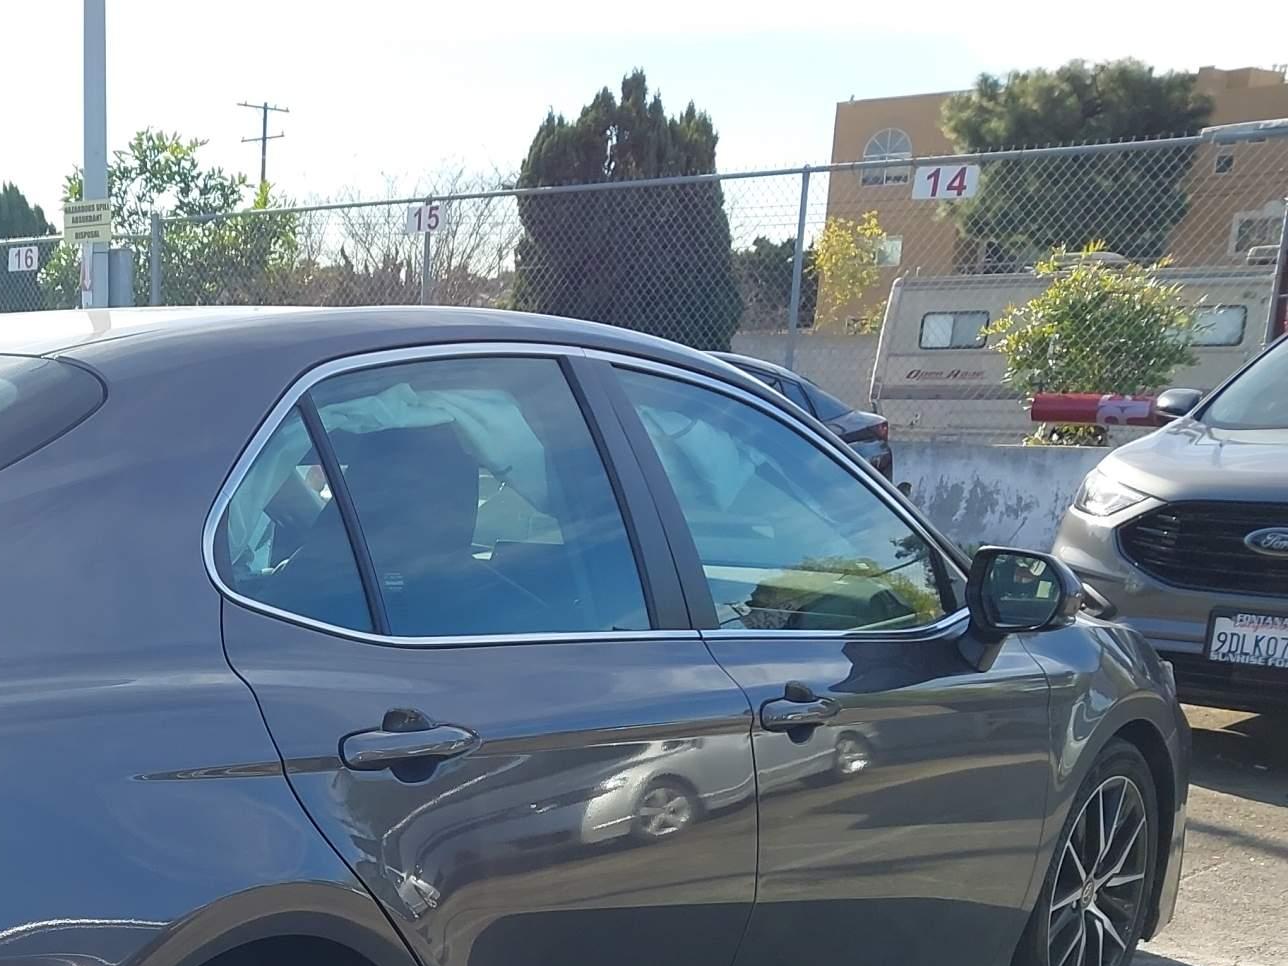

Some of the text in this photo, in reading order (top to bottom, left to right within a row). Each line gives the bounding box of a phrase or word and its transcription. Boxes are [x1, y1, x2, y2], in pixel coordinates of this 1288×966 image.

[927, 167, 968, 197] 14
[414, 206, 440, 231] 15
[75, 230, 100, 240] DISPOSAL
[15, 248, 34, 269] 16
